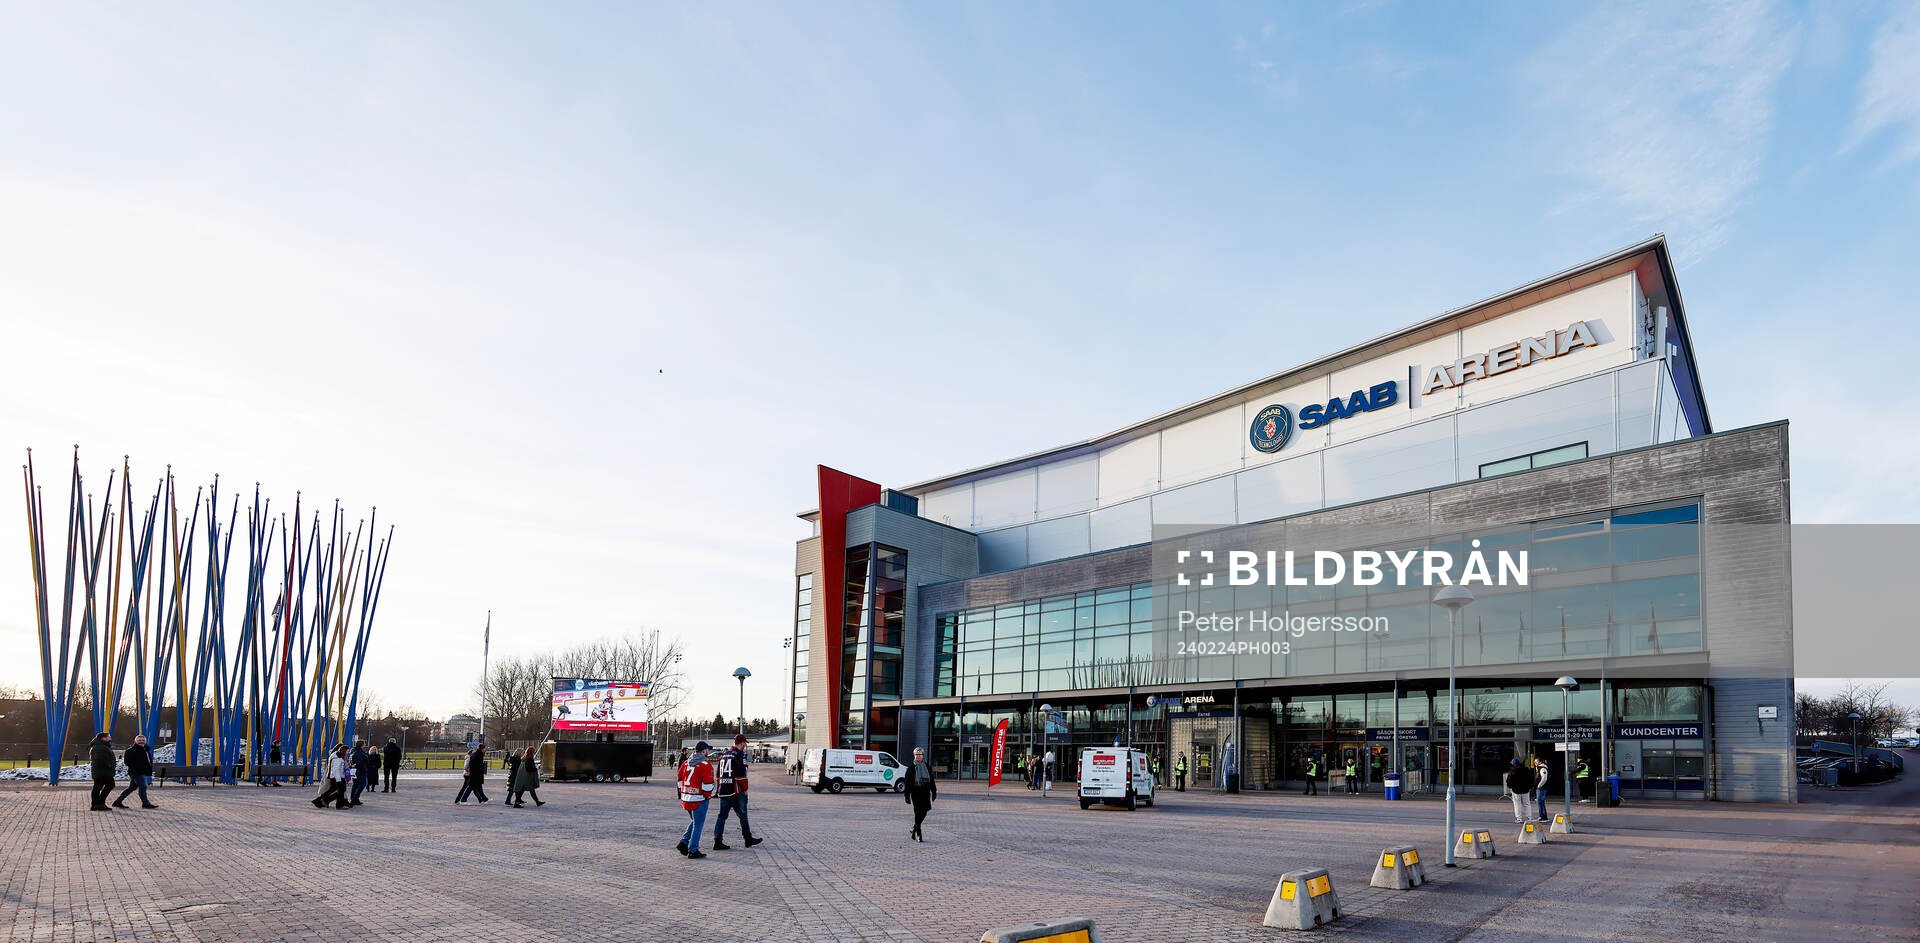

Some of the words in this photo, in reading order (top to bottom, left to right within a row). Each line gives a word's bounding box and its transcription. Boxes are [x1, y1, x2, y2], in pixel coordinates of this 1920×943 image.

[1299, 380, 1398, 430] SAAB
[1422, 320, 1598, 395] ARENA
[1260, 409, 1281, 419] SAAB
[1184, 695, 1215, 704] ARENA
[1621, 727, 1698, 736] KUNDCENTER
